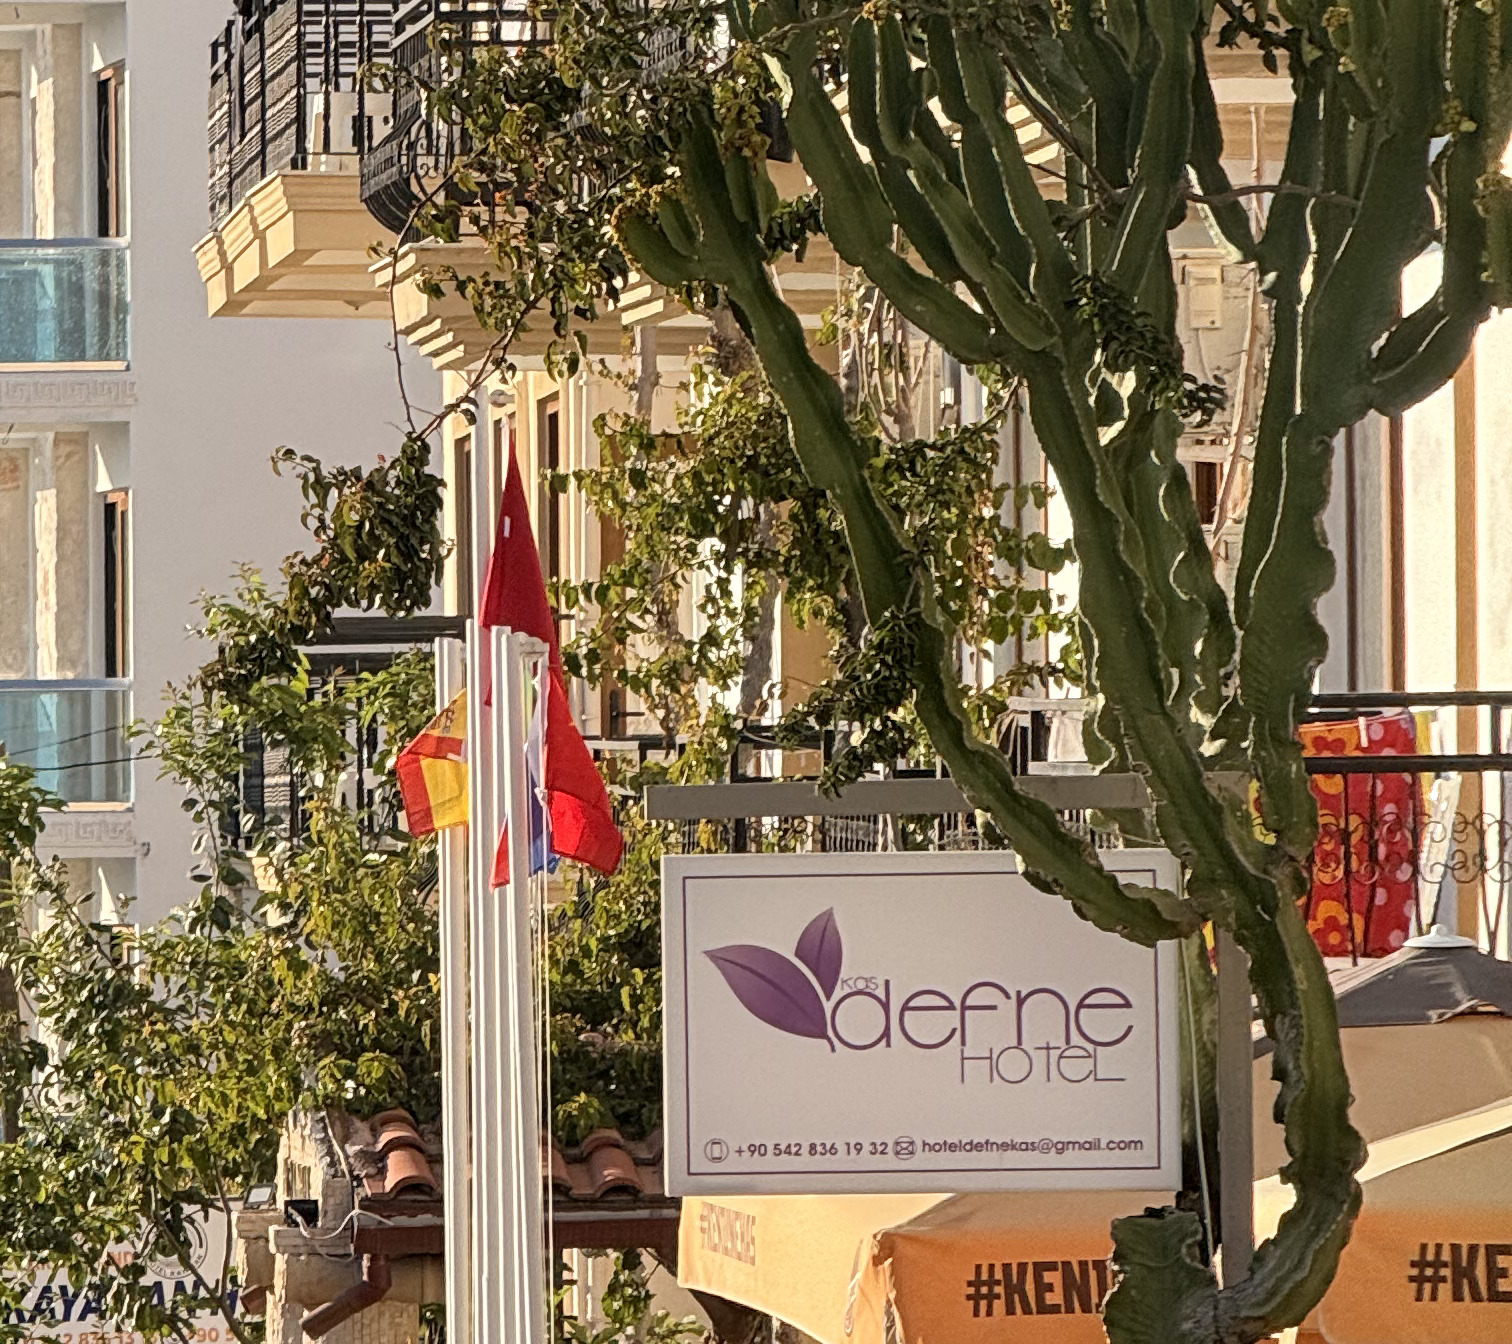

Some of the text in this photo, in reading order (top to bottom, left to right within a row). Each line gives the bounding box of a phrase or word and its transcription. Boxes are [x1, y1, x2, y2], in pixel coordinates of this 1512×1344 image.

[830, 979, 1134, 1051] defne
[735, 1137, 1144, 1157] +90 542 836 19 32 hoteldefnekas@gmail.com
